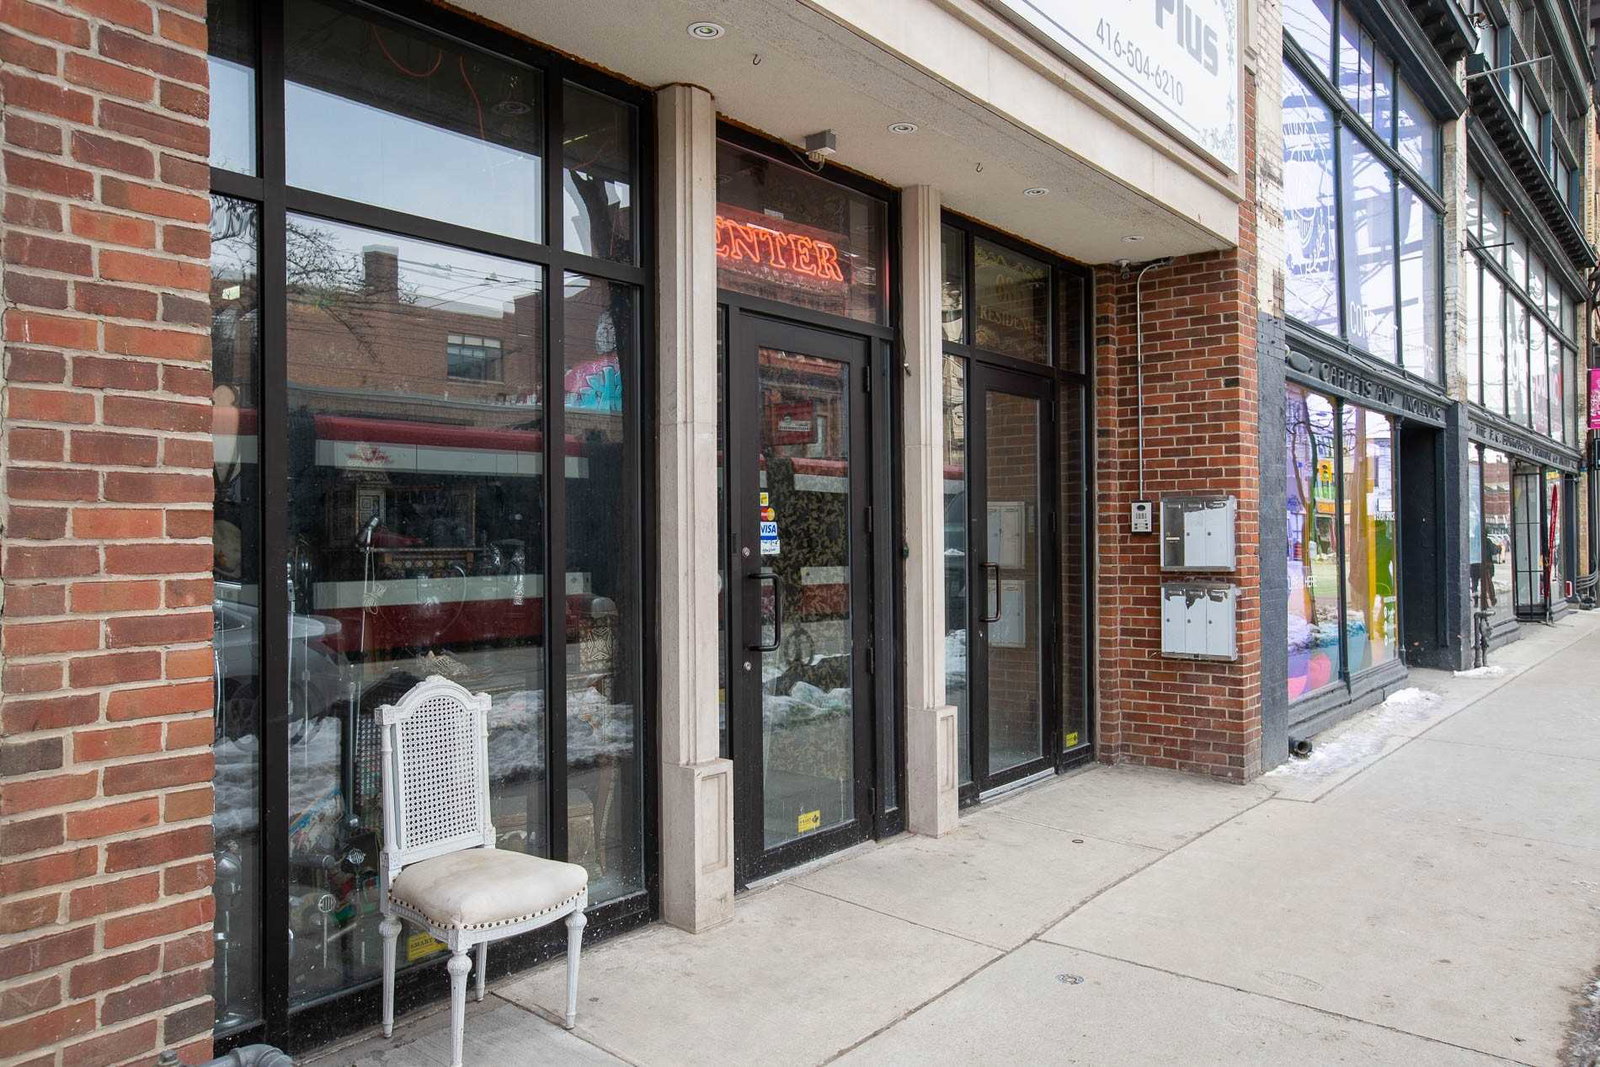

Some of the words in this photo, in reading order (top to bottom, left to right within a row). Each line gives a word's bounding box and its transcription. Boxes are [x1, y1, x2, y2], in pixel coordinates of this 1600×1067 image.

[1096, 17, 1184, 106] 416-504-6210
[1319, 362, 1373, 398] CARPETS
[1376, 385, 1395, 406] AND
[761, 524, 777, 534] VISA
